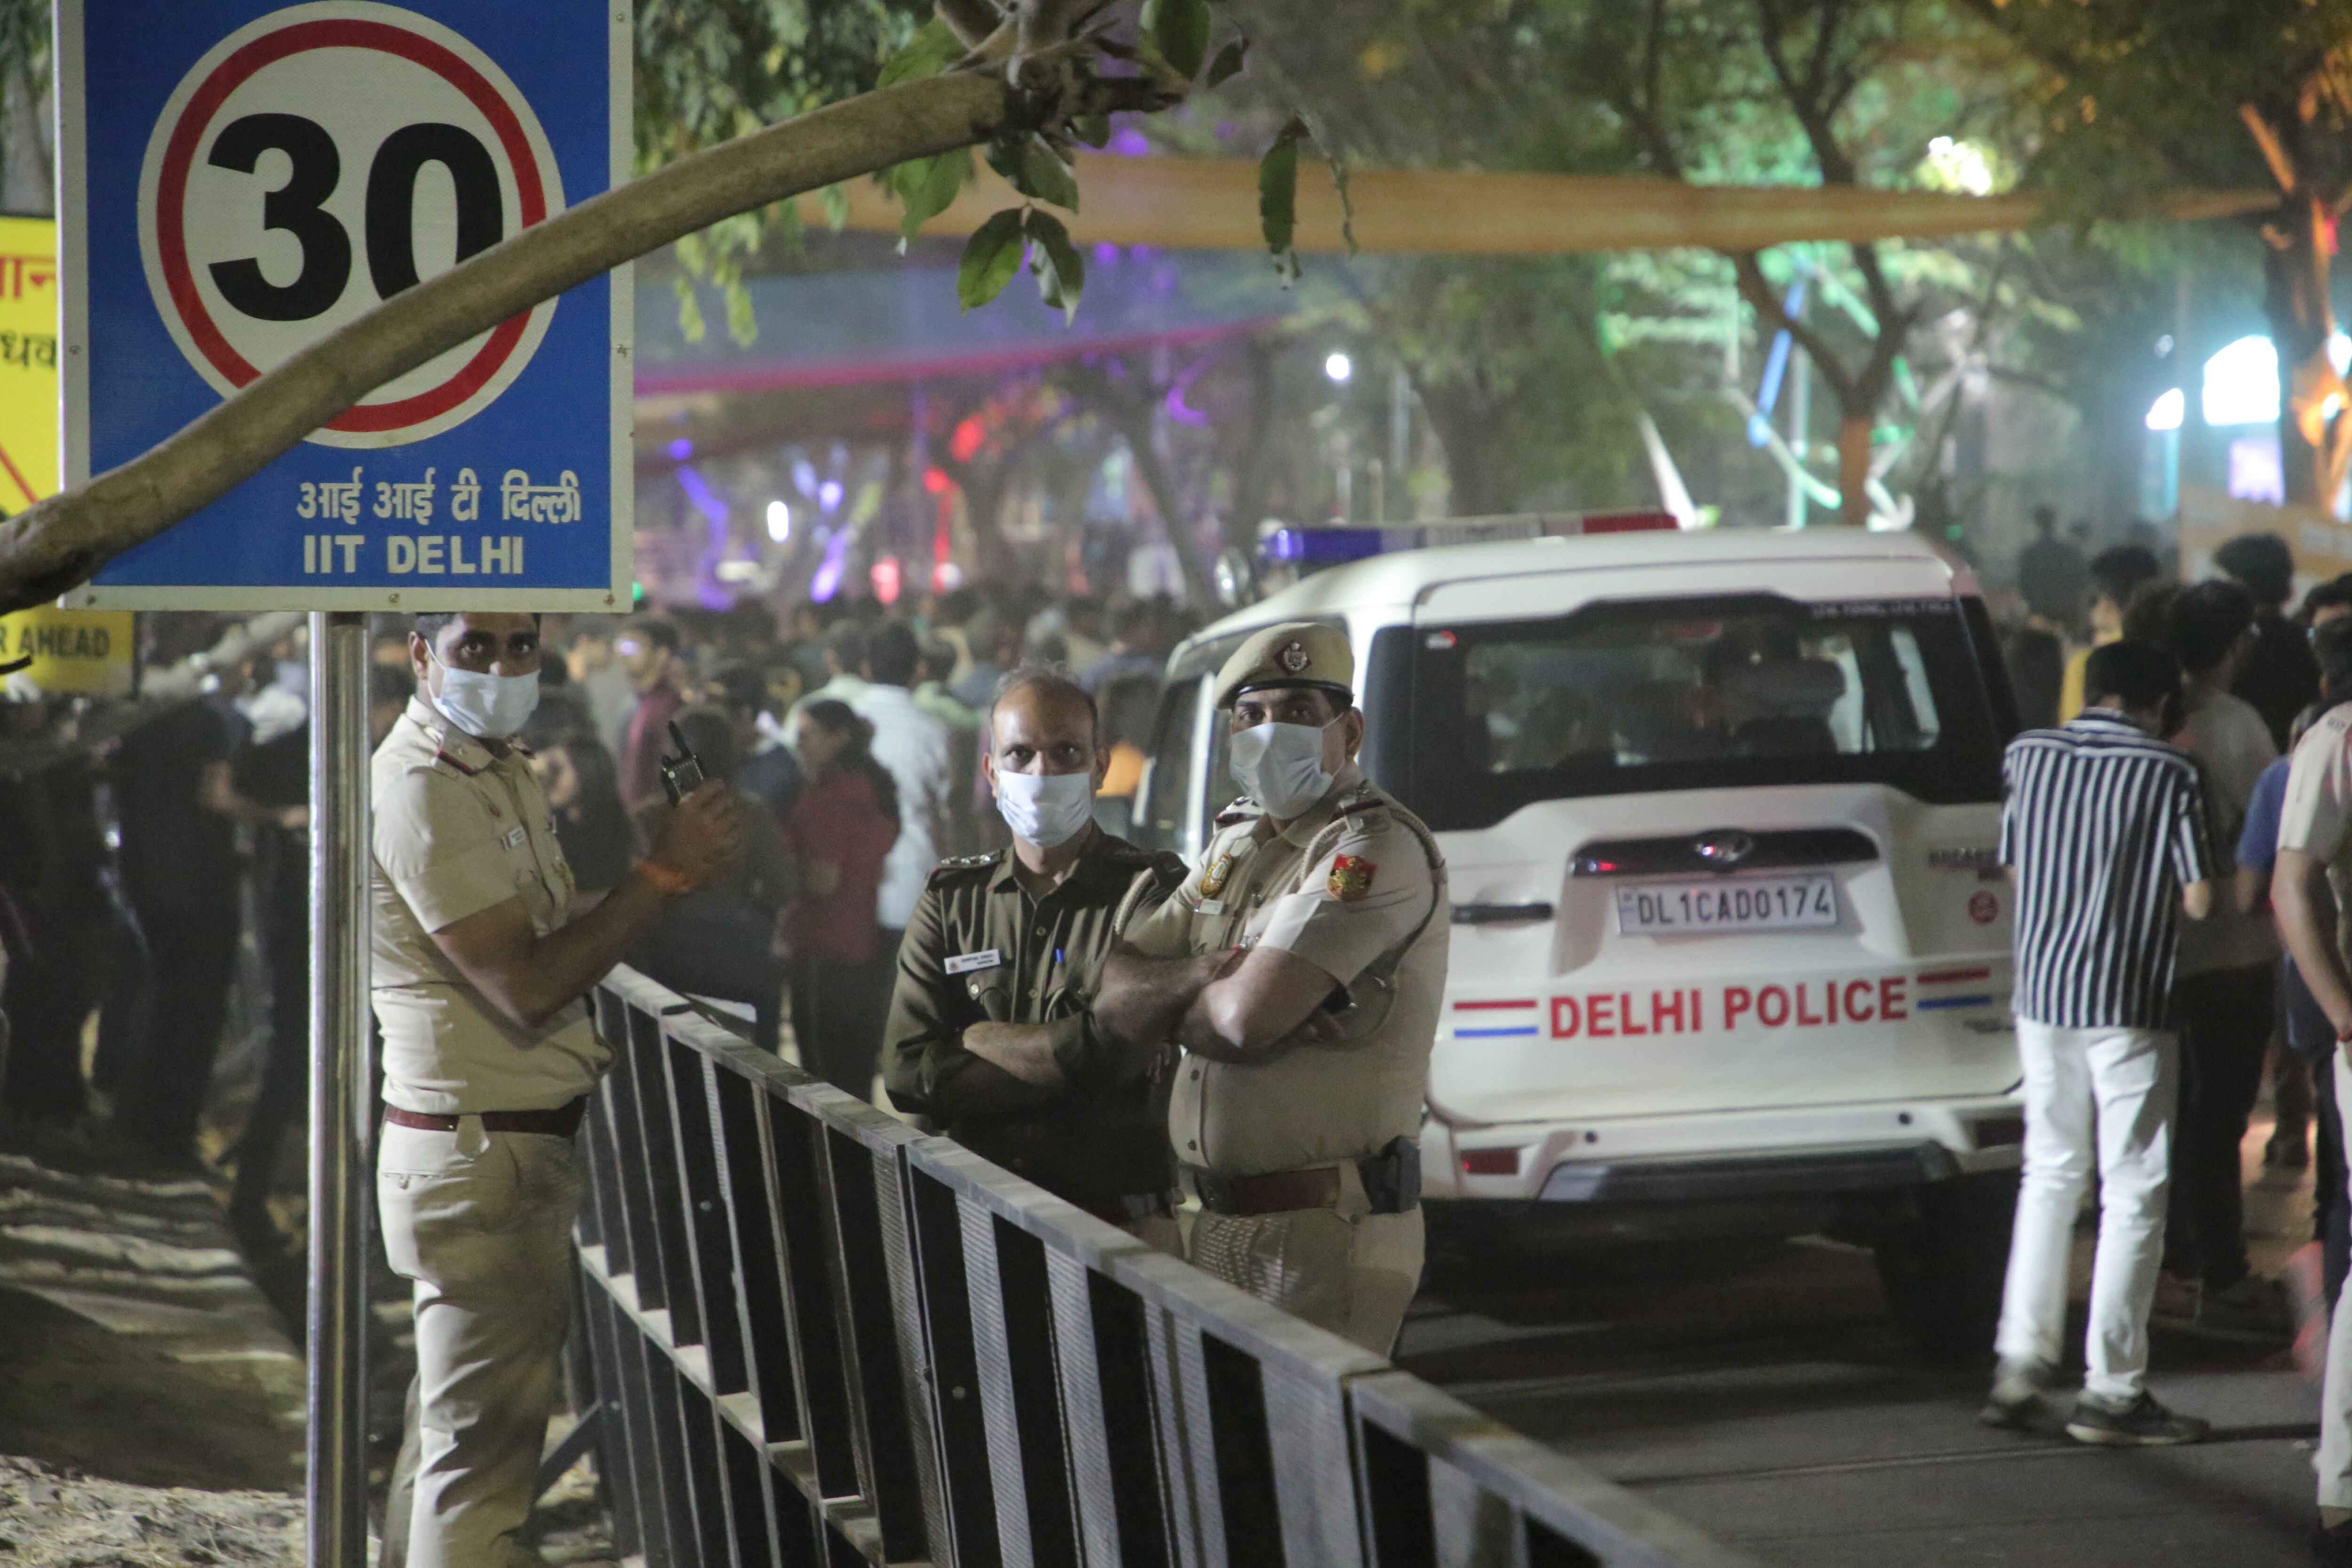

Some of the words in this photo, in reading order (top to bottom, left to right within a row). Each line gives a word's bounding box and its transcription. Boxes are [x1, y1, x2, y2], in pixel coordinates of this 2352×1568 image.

[208, 113, 503, 321] 30
[297, 466, 363, 525] आई
[373, 467, 436, 525] आई
[450, 467, 482, 521] टी
[501, 469, 580, 524] दिल्ली
[304, 534, 365, 573] IIT
[387, 535, 523, 574] DELHI
[19, 625, 111, 658] AHEAD
[1550, 988, 1702, 1040] DELHI
[1724, 976, 1908, 1031] POLICE
